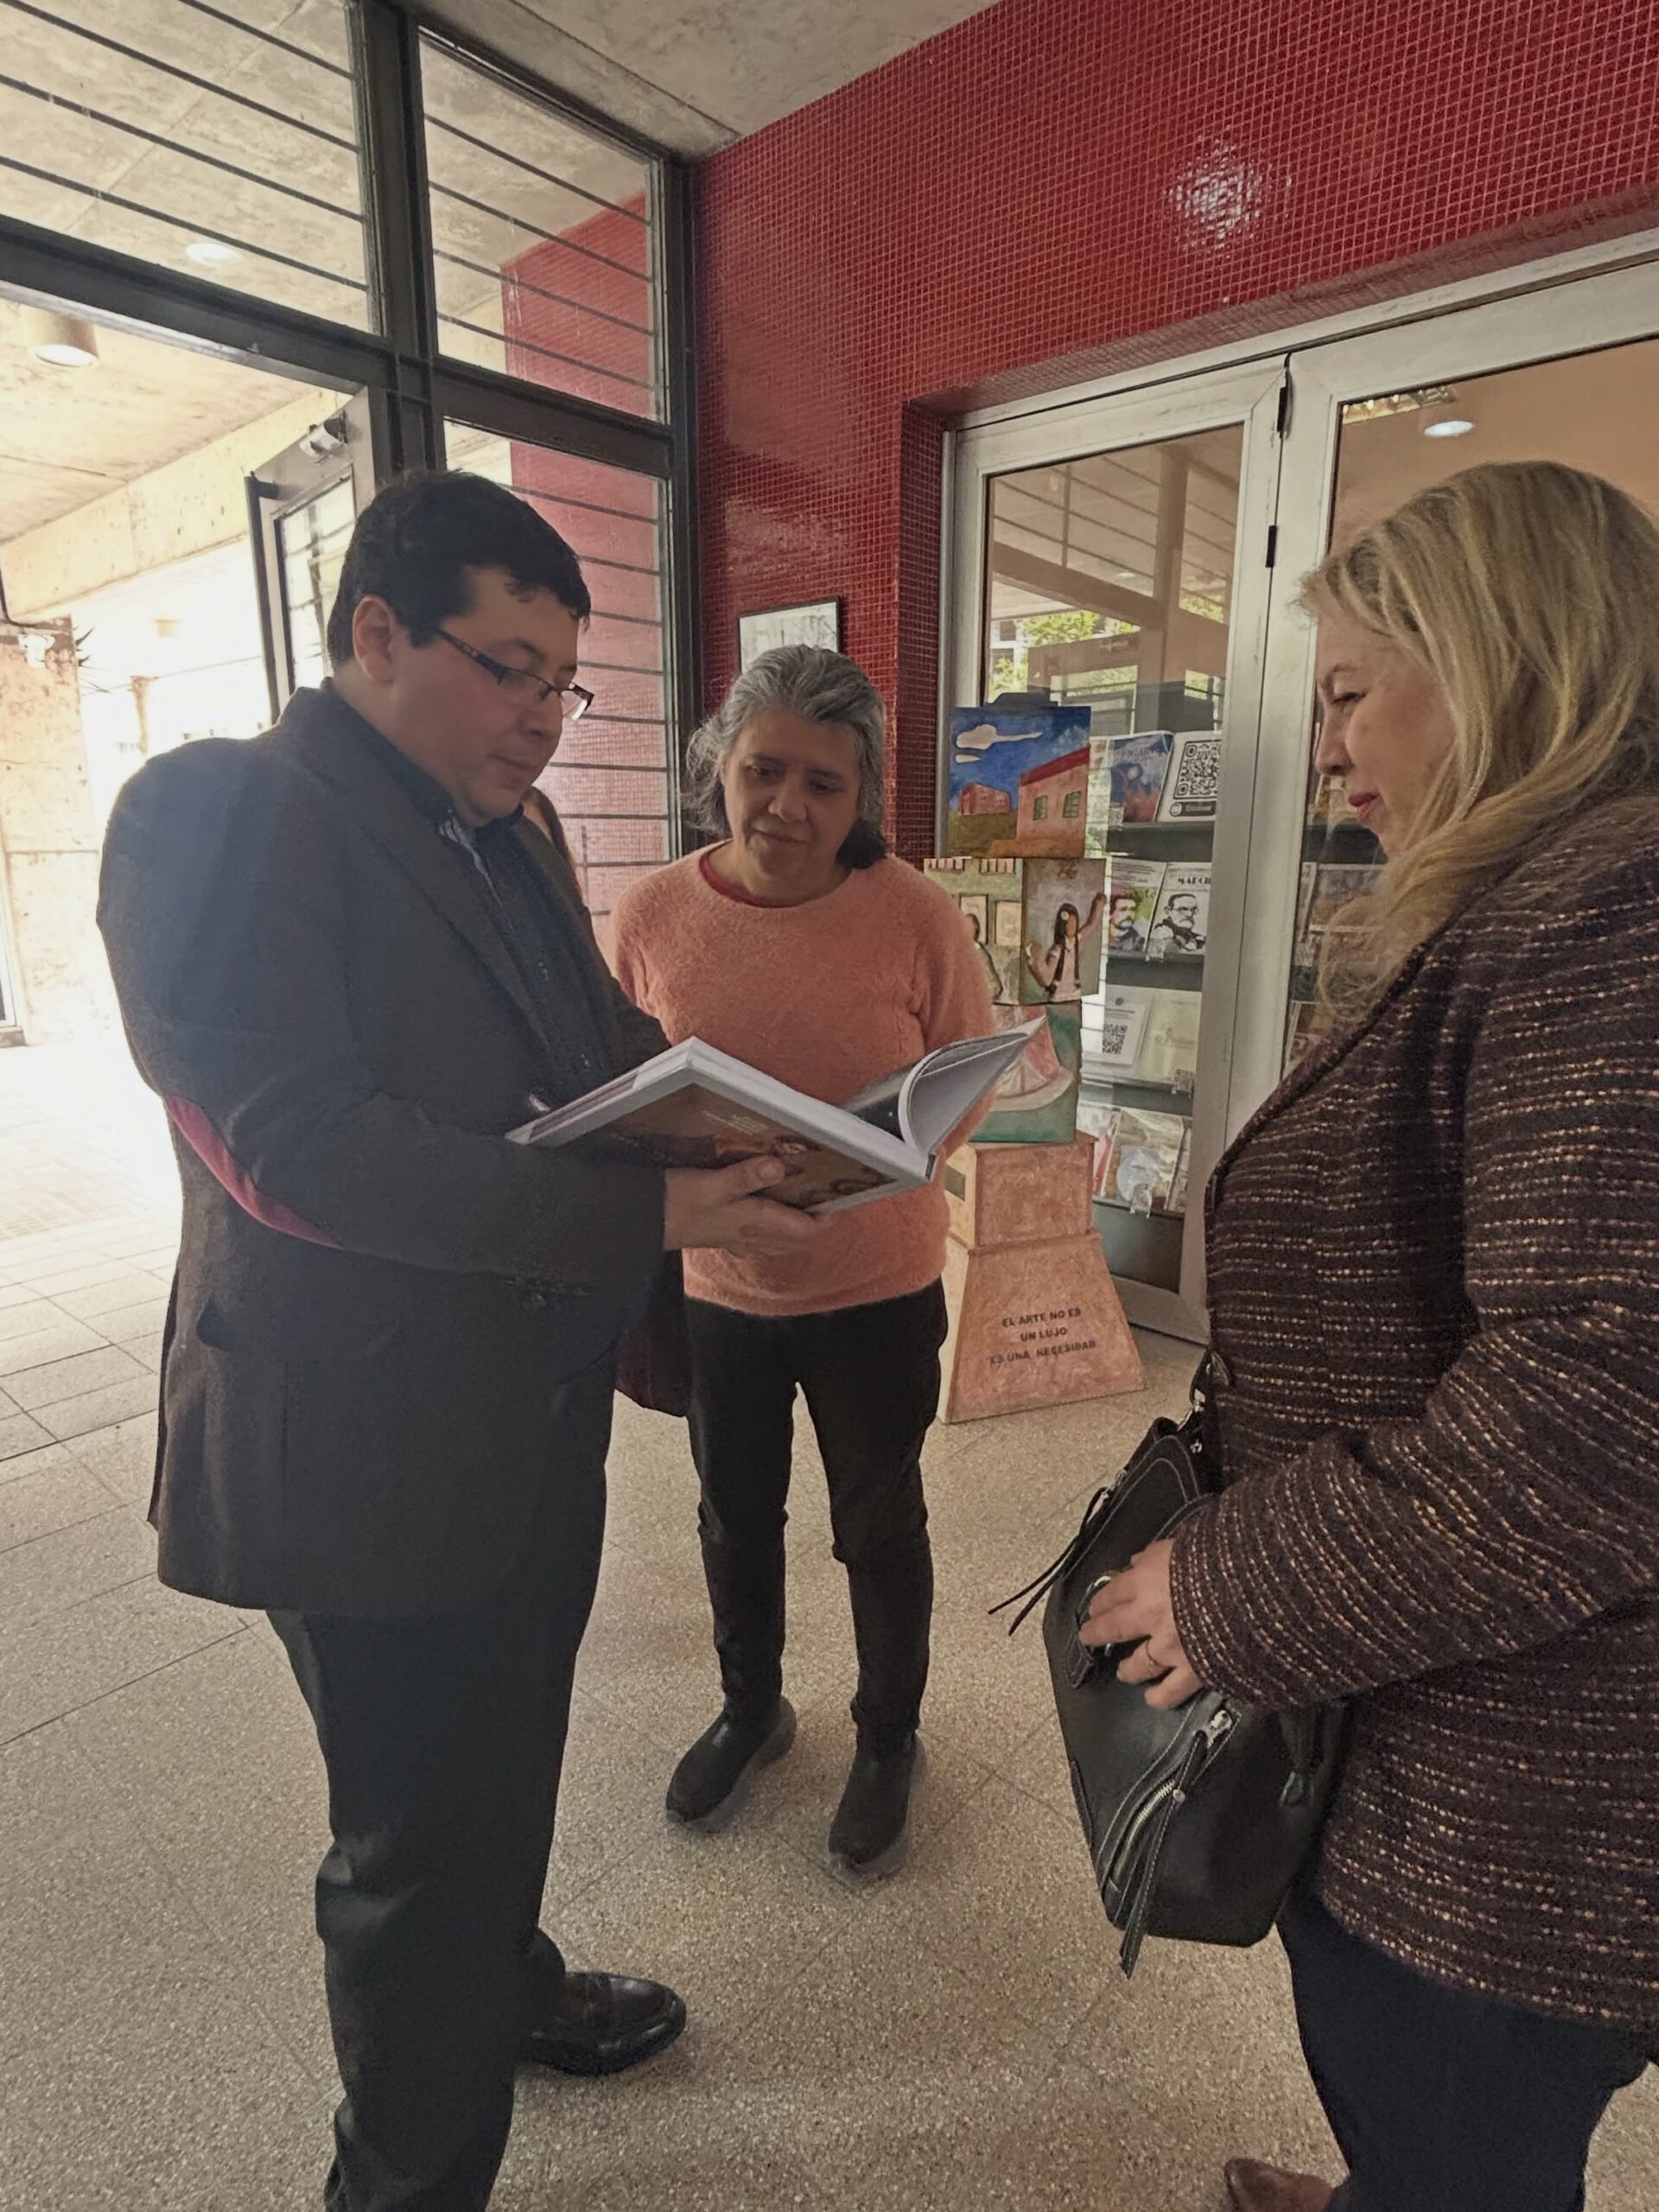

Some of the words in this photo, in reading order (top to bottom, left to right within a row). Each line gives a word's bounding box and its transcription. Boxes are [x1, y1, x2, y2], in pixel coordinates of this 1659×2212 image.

[1002, 1317, 1015, 1327] EL
[1019, 1313, 1047, 1325] ARTE
[1050, 1310, 1065, 1319] NO
[1068, 1306, 1082, 1318] ES
[1020, 1332, 1036, 1342] UN
[1039, 1326, 1068, 1339] LUJO
[1007, 1350, 1030, 1362] UNA
[1037, 1340, 1096, 1357] NECESIDAD
